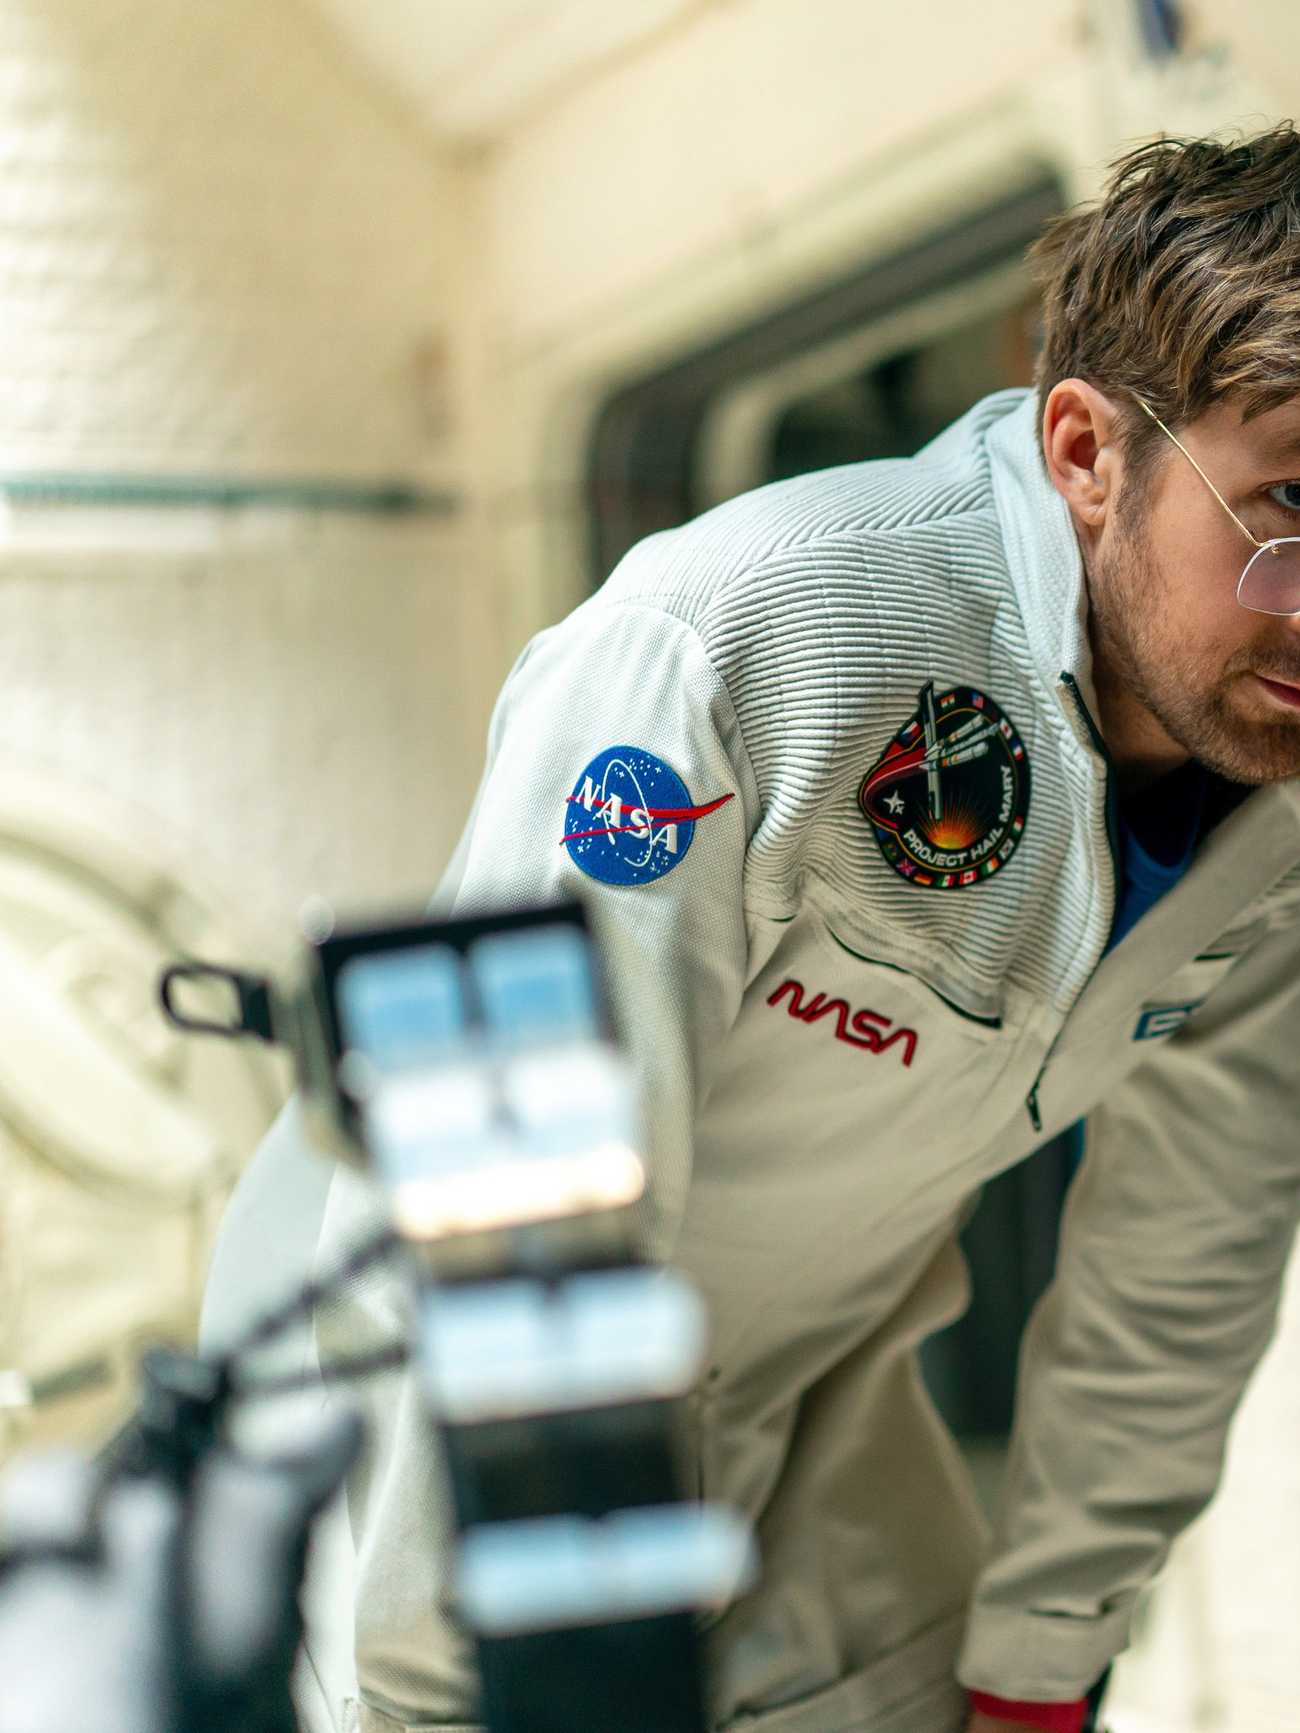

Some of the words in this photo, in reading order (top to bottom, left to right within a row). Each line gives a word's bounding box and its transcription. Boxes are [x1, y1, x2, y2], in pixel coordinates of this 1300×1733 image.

[574, 775, 678, 854] NASA
[903, 828, 968, 867] PROJECT
[970, 827, 1003, 860] HAIL
[999, 765, 1013, 822] MARY
[767, 980, 918, 1067] NASA
